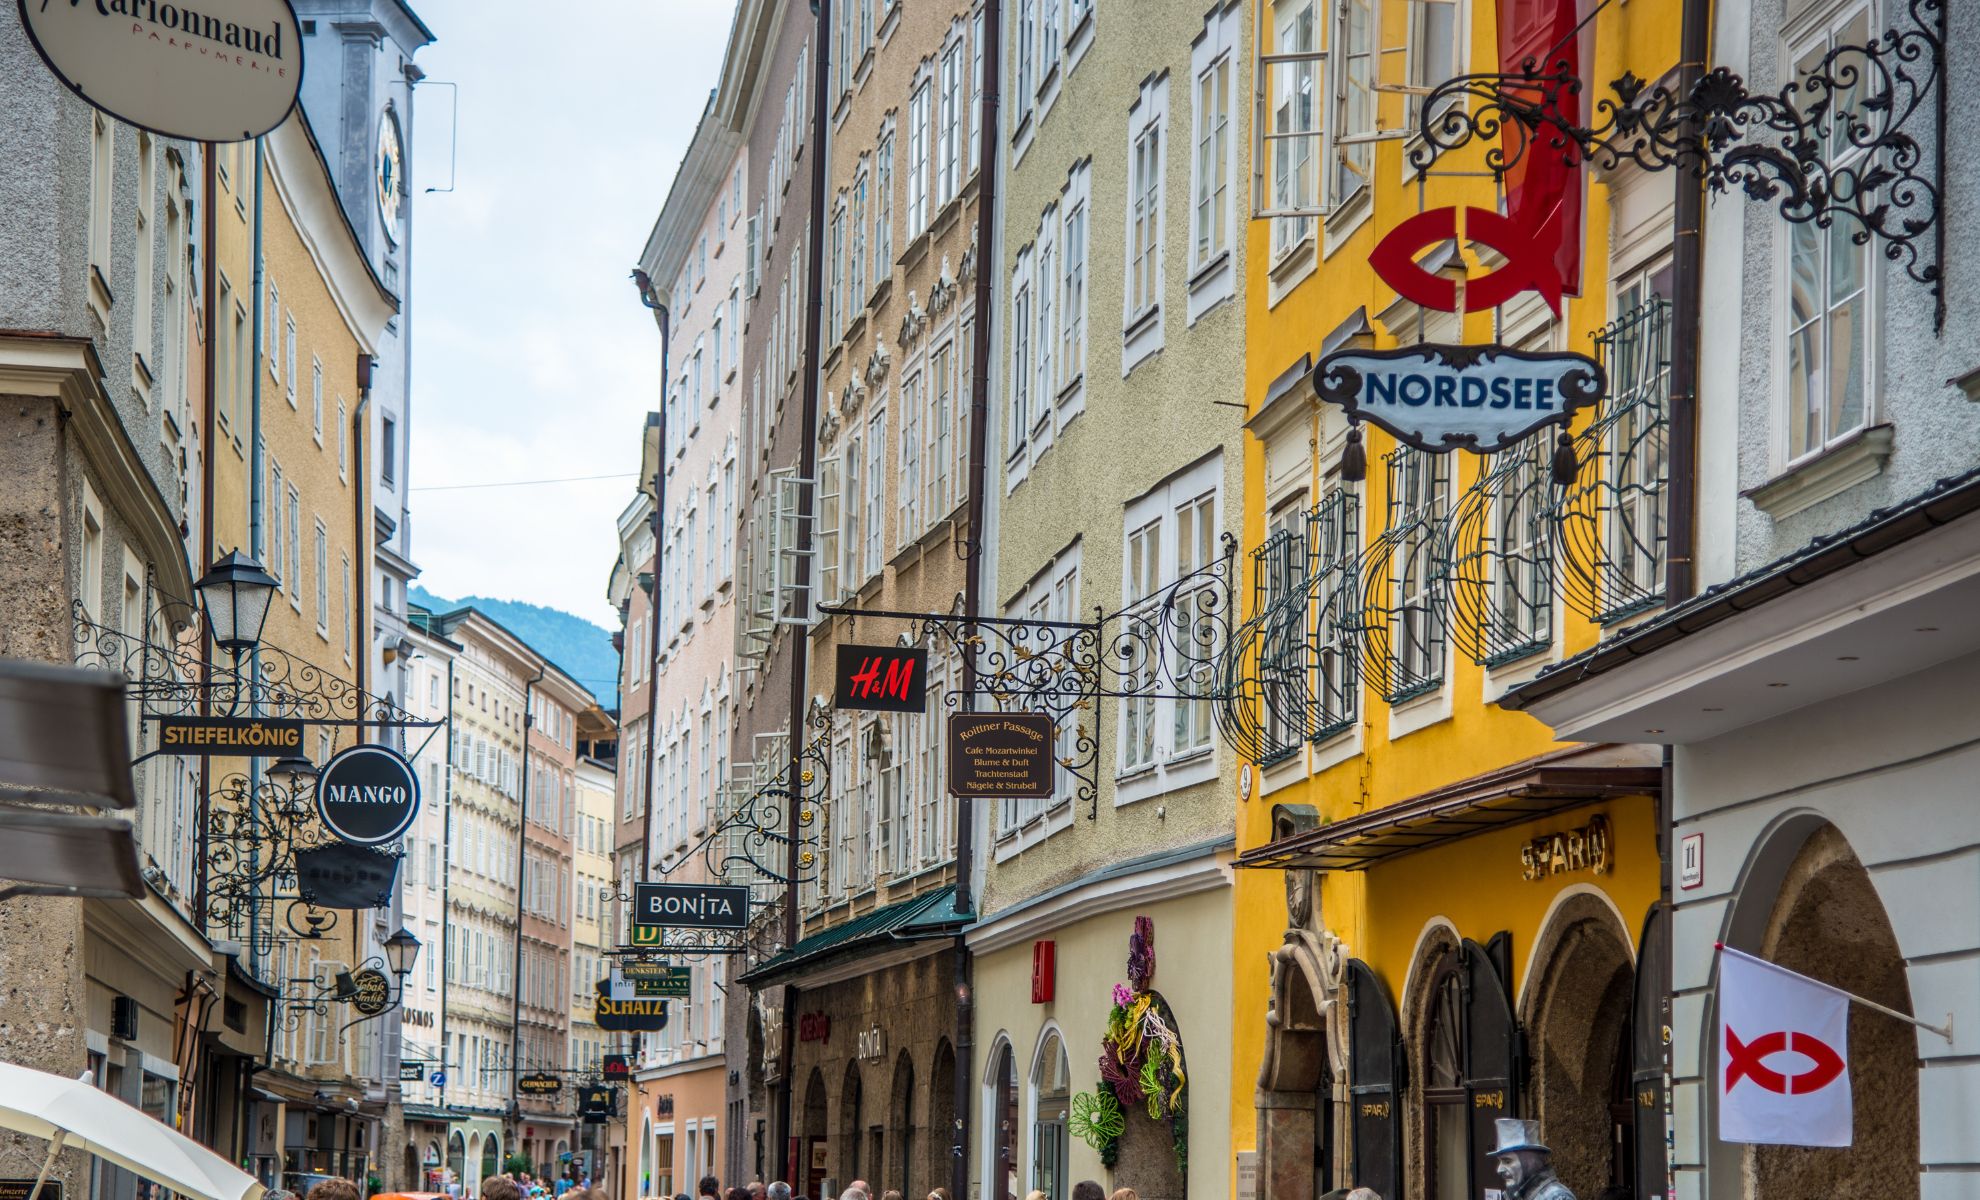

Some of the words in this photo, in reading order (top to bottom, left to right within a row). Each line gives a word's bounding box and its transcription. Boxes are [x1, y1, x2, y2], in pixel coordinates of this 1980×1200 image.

[1366, 372, 1555, 411] NORDSEE
[850, 656, 915, 702] H&M
[165, 722, 300, 747] STIEFELKÖNIG
[960, 722, 1000, 741] Roittner
[1003, 721, 1043, 742] Passage
[985, 747, 1038, 755] Mozartwinkel
[974, 759, 1001, 767] Blume
[1002, 759, 1011, 767] &
[1012, 759, 1030, 767] Duft
[975, 770, 1029, 778] Trachtenstadl
[996, 782, 1004, 790] &
[1006, 782, 1038, 790] Strubell
[329, 785, 407, 804] MANGO
[625, 967, 668, 975] DENKSTEIN
